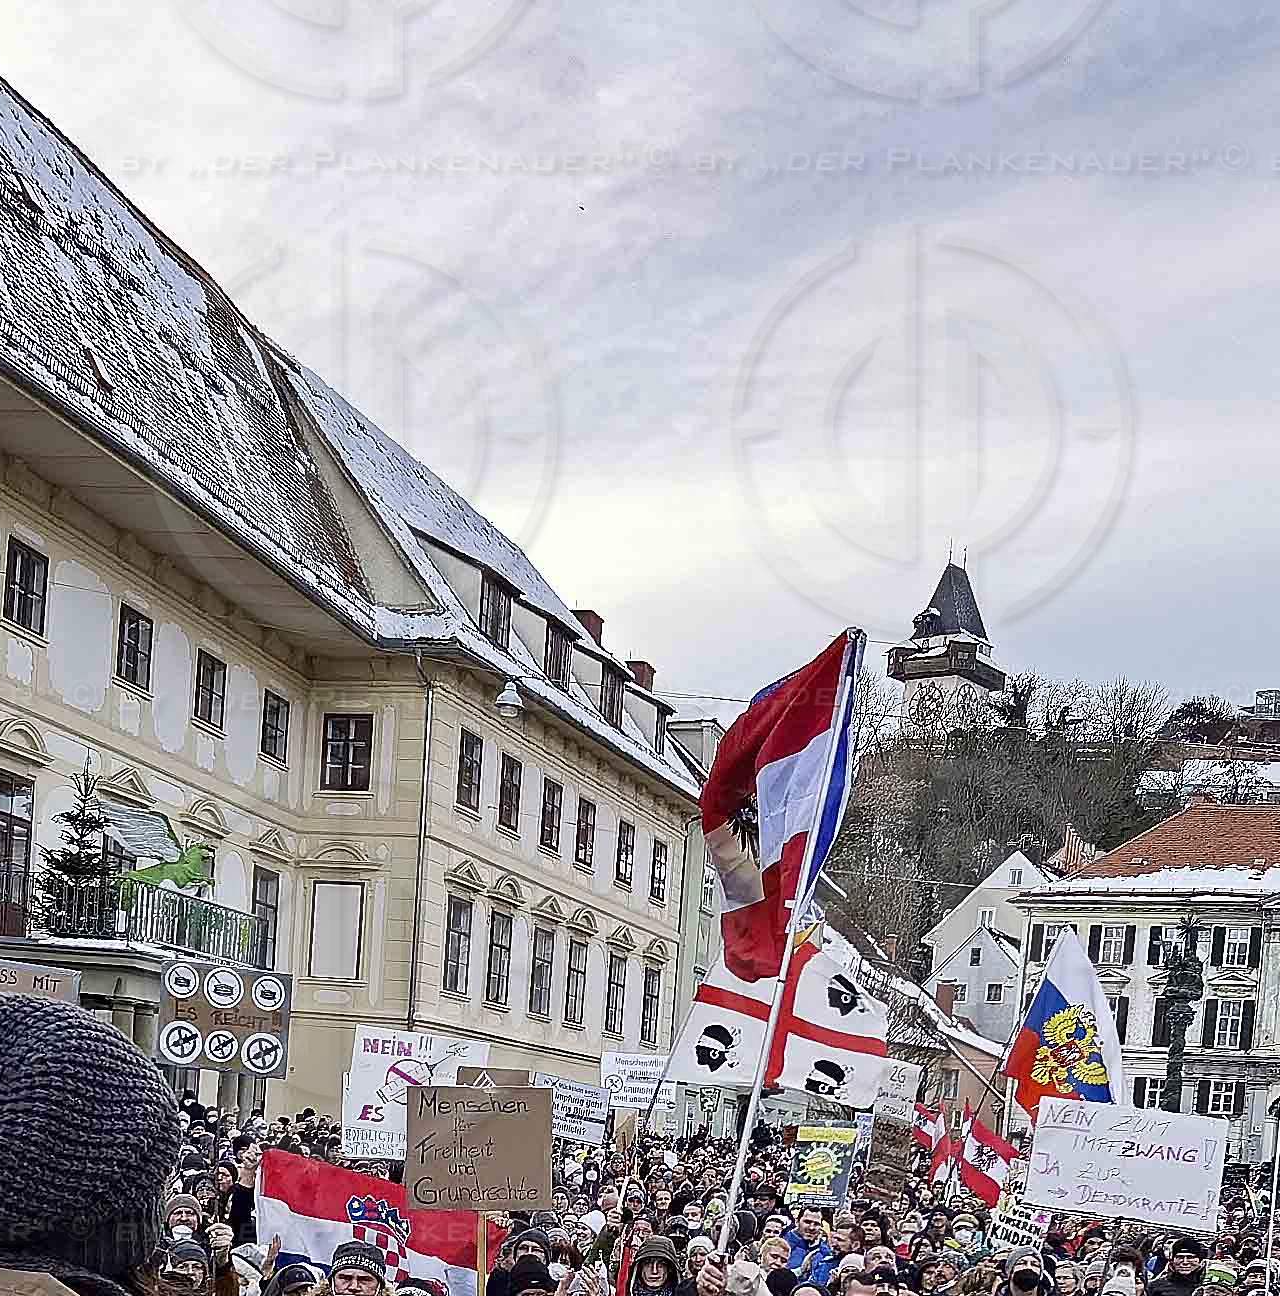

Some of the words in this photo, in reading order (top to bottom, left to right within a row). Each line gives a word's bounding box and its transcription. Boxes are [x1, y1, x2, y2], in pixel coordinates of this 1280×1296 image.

[33, 974, 63, 994] MIT
[175, 1000, 199, 1021] ES
[363, 1032, 413, 1057] NEIN
[357, 1104, 385, 1123] ES
[420, 1088, 531, 1119] Menschen
[1041, 1104, 1097, 1128] NEIN
[415, 1132, 496, 1165] Freiheit
[448, 1160, 477, 1176] und
[1033, 1152, 1064, 1176] JA
[413, 1176, 538, 1205] Grundrechte
[990, 1223, 1041, 1250] KINDERN
